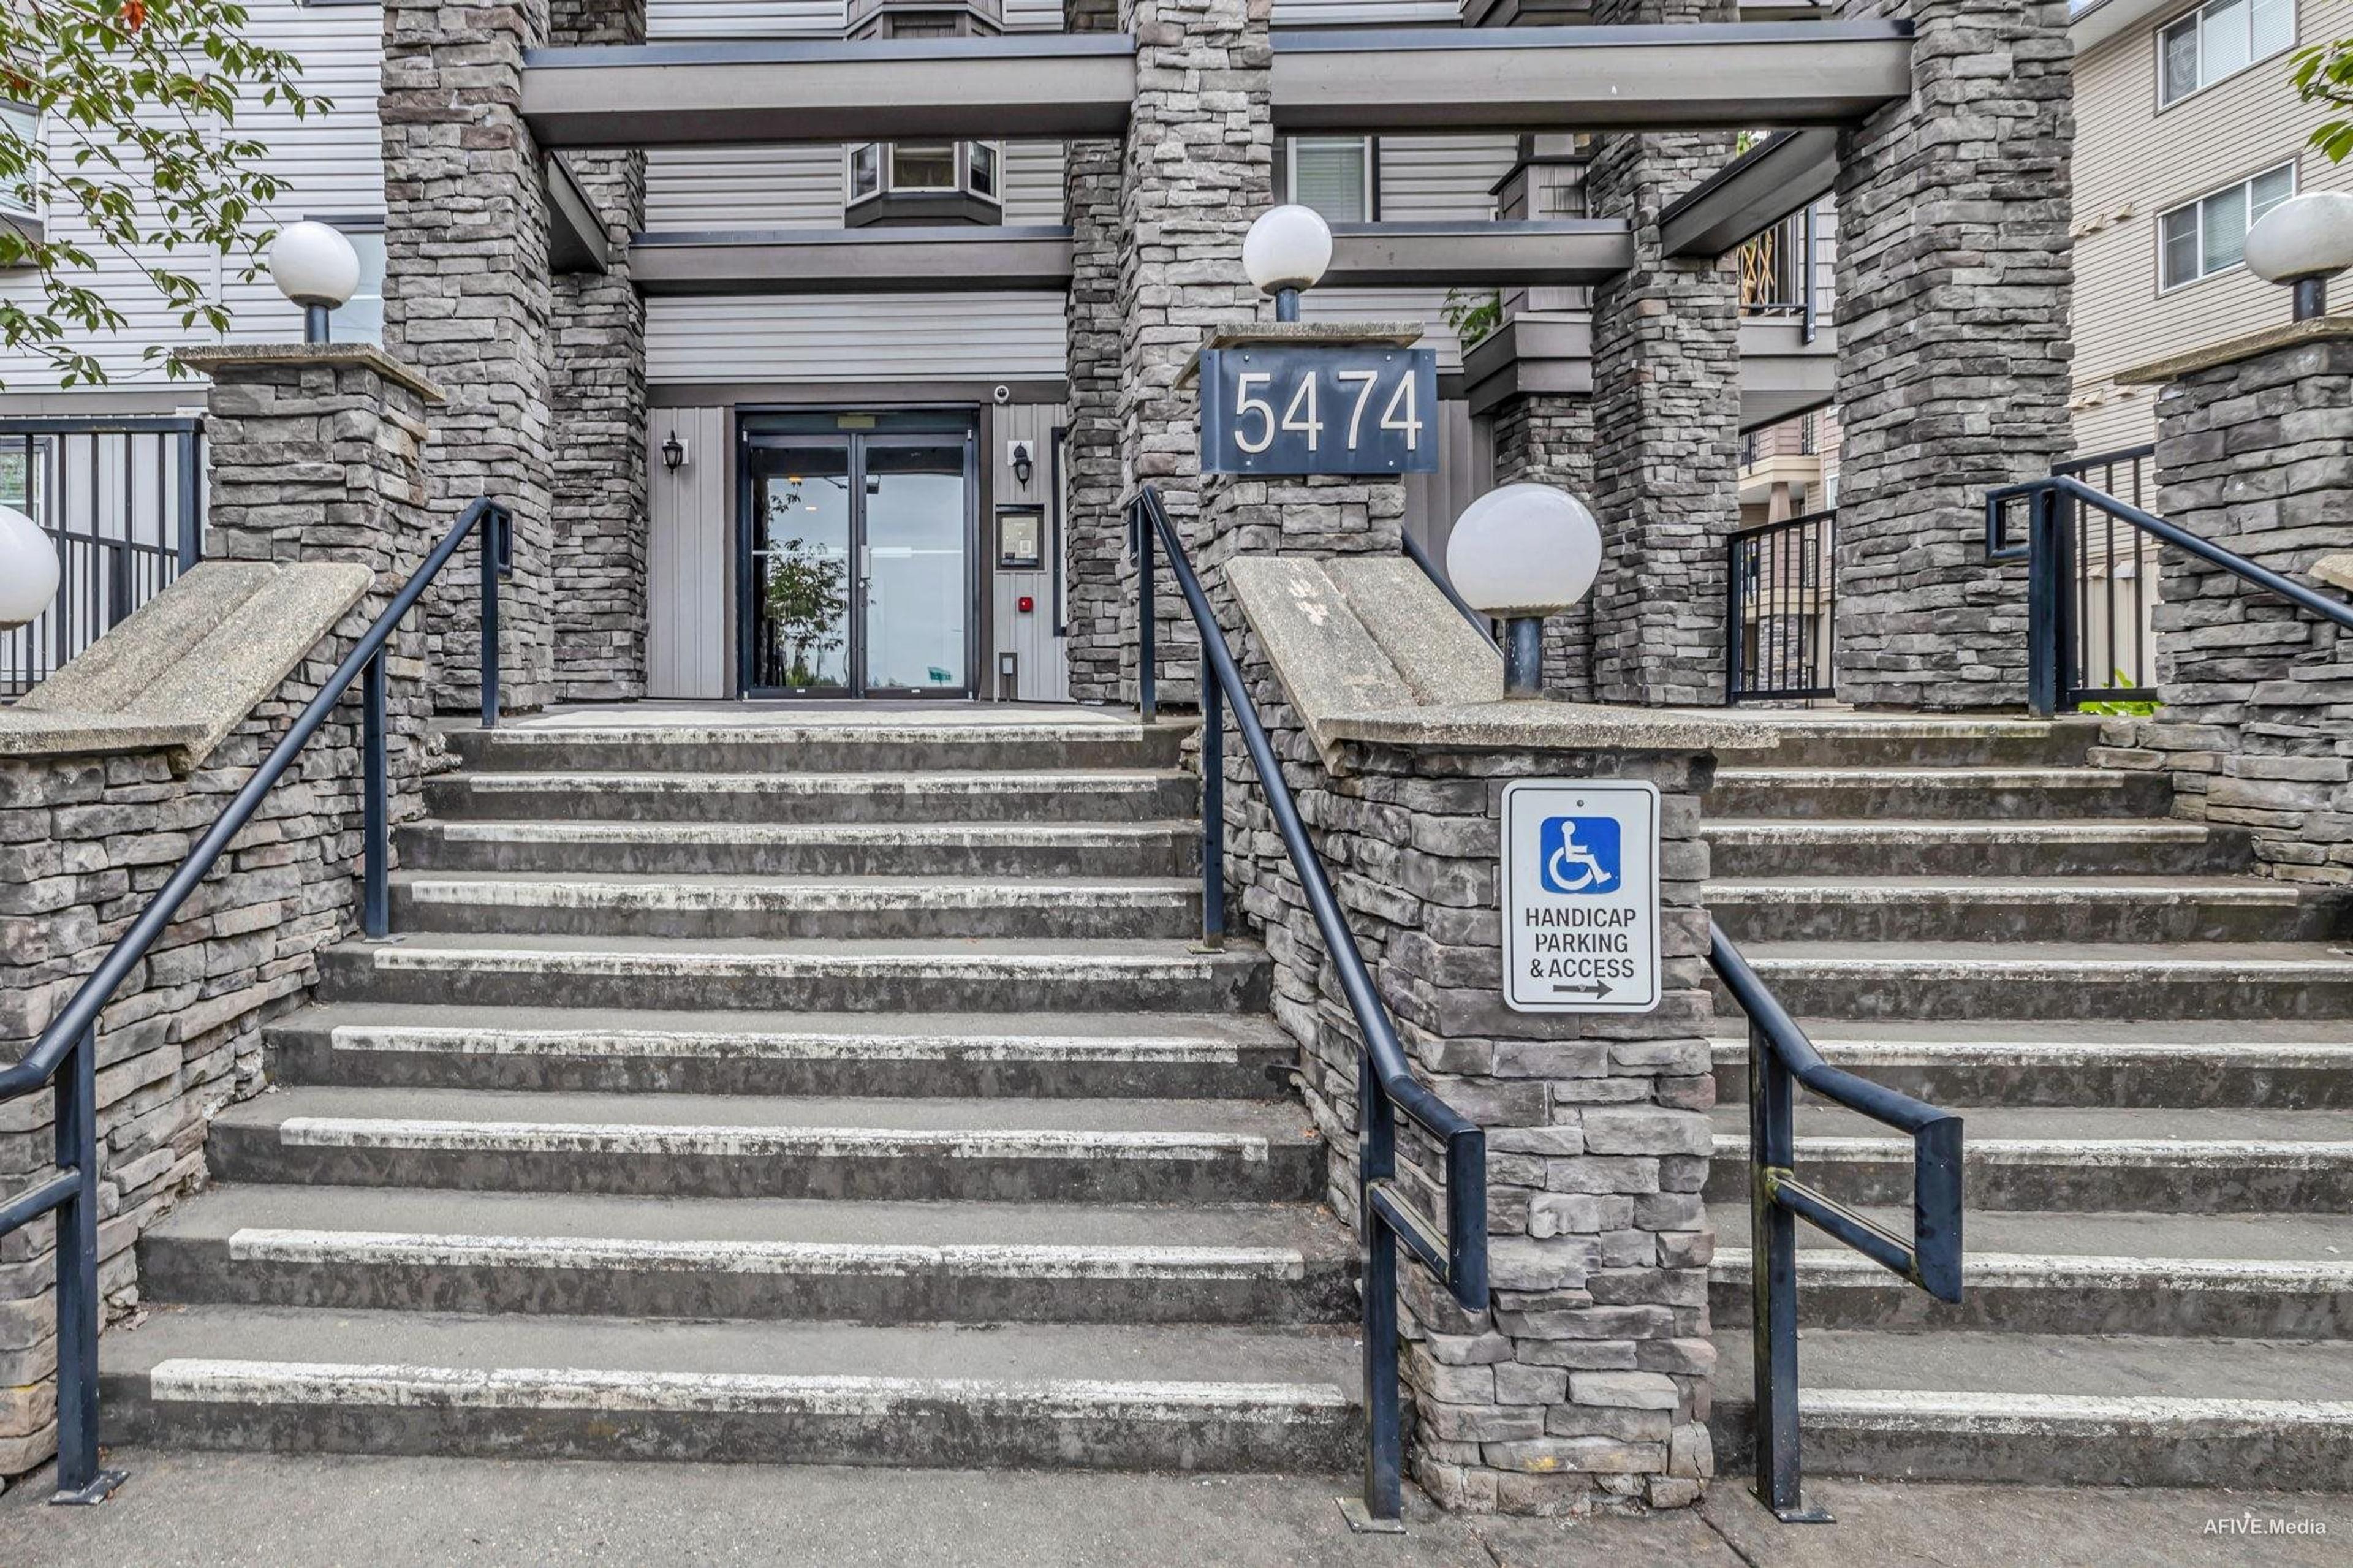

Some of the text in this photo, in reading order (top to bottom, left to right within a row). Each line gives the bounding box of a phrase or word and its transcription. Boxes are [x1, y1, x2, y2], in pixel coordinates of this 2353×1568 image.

[1234, 370, 1422, 453] 5474
[1526, 907, 1636, 928] HANDICAP
[1535, 933, 1628, 953] PARKING
[1530, 958, 1634, 978] & ACCESS
